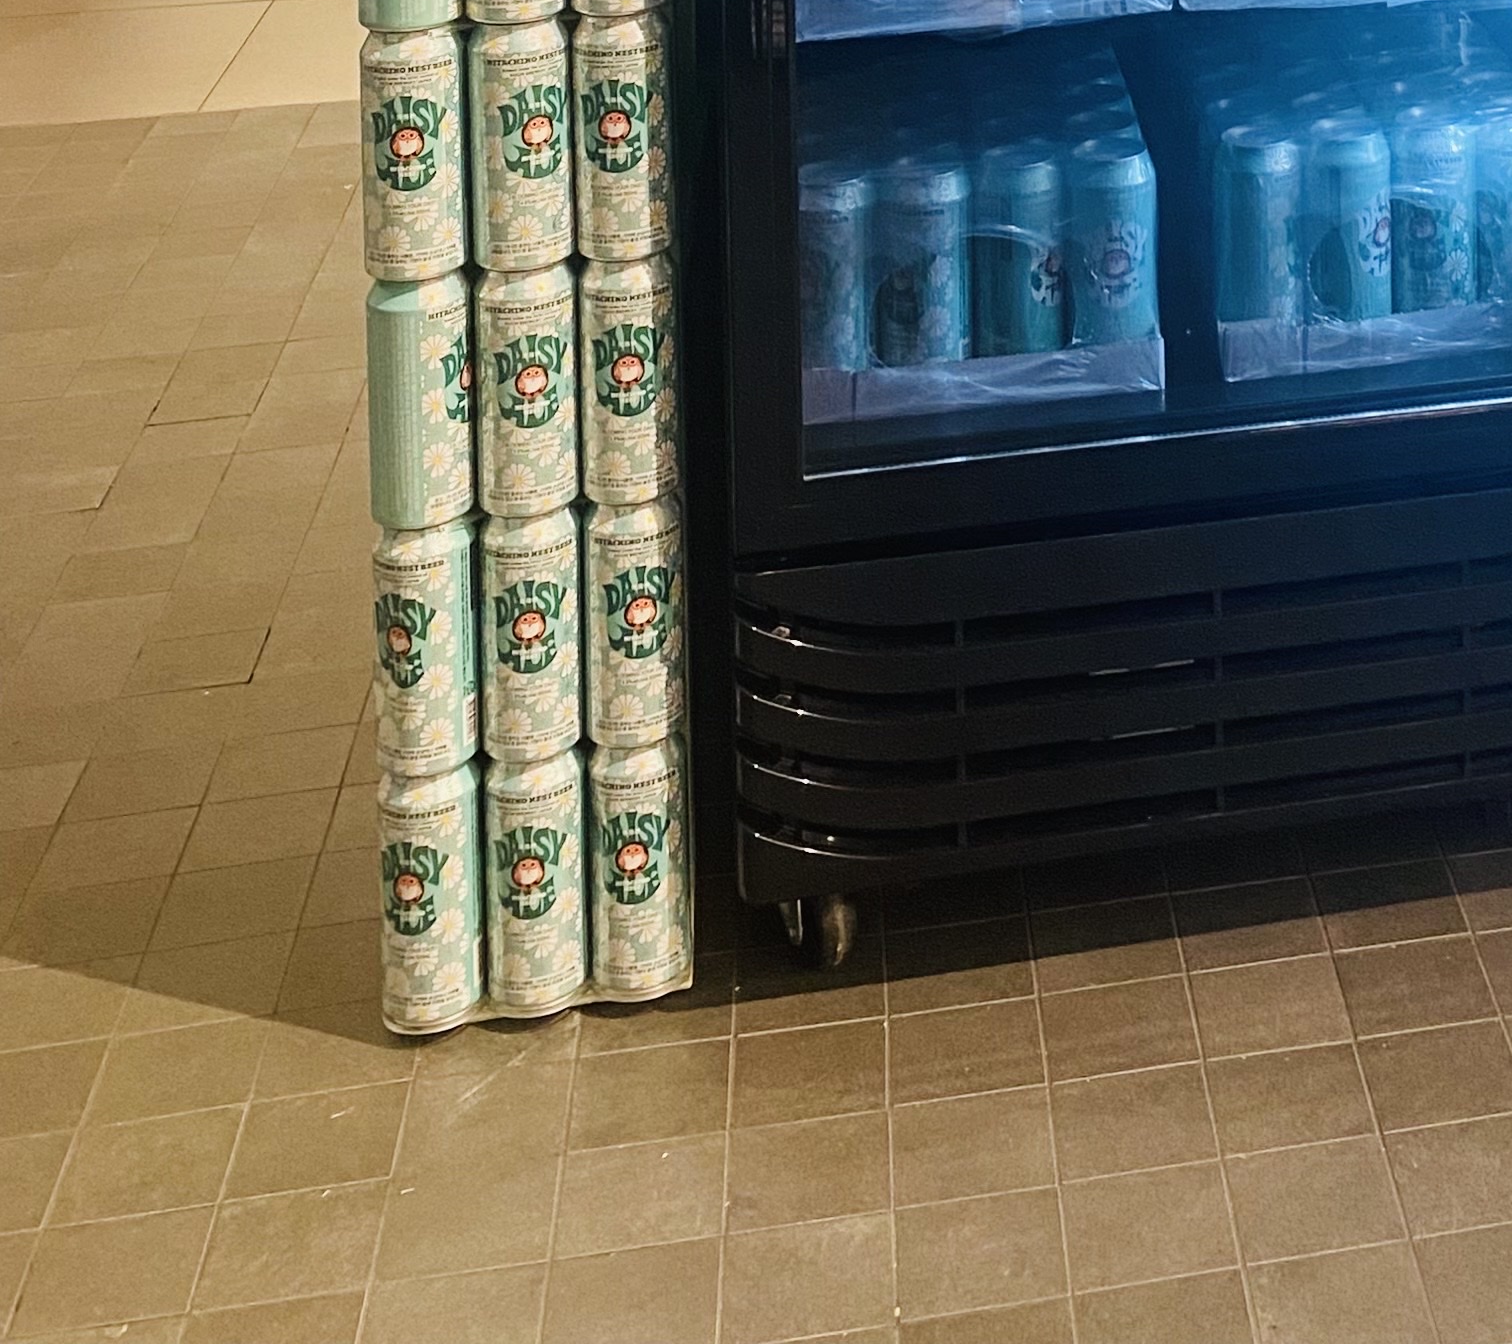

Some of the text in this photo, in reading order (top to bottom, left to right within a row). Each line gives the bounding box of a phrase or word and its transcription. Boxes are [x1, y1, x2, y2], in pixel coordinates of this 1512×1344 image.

[371, 96, 446, 144] DAISY
[580, 79, 653, 129] DAISY
[494, 333, 568, 383] DAISY
[593, 324, 667, 373] DAISY
[493, 580, 568, 629] DAISY
[602, 566, 676, 617] DAISY
[493, 826, 568, 871] DAISY
[602, 811, 671, 857] DAISY
